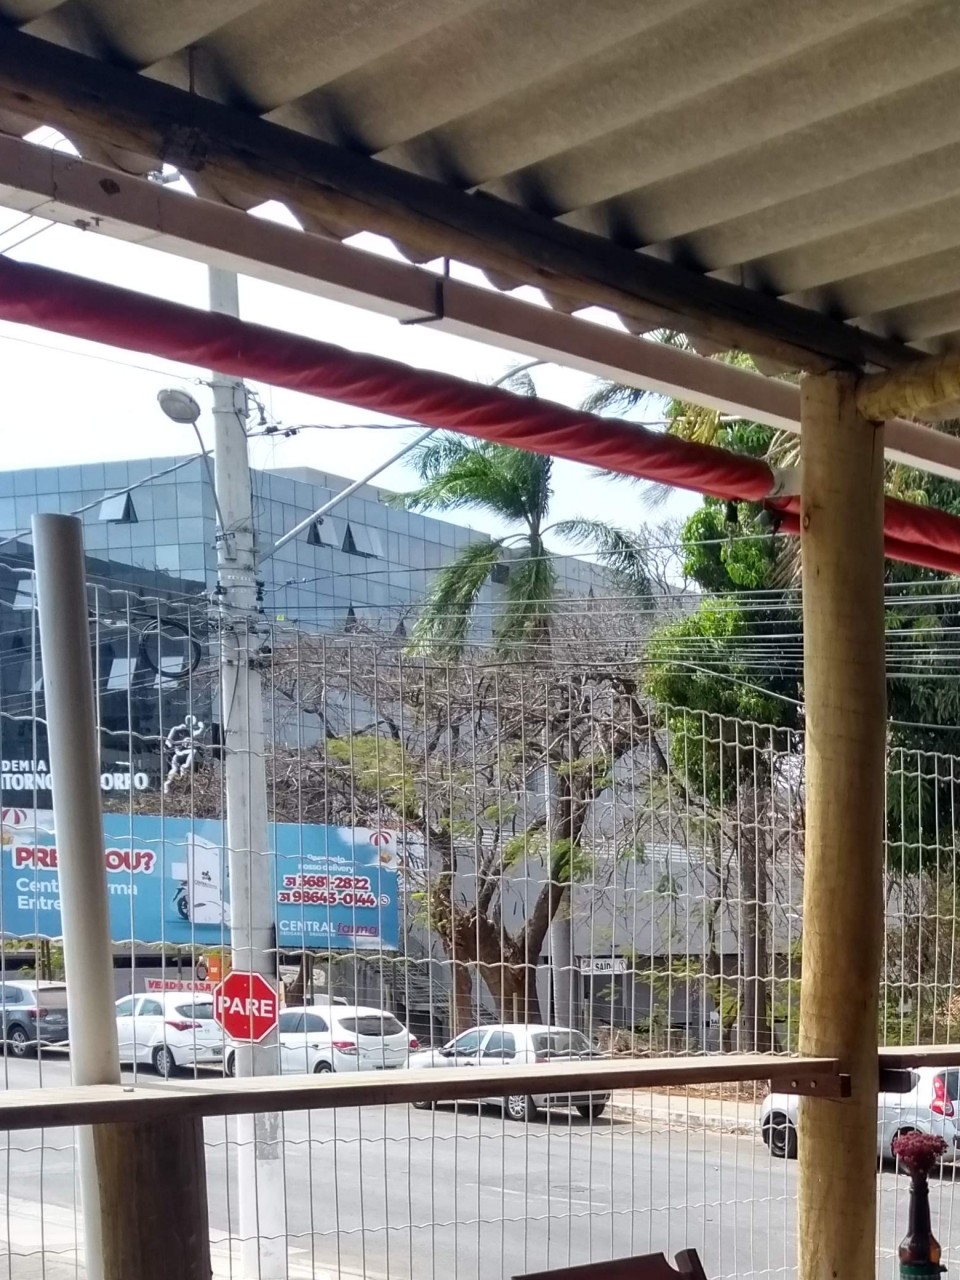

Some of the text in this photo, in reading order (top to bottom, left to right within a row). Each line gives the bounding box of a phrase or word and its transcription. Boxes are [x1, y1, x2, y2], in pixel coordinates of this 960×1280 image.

[101, 773, 148, 790] ORPO
[16, 878, 58, 892] Cent
[280, 920, 336, 932] CENTRAL
[218, 996, 273, 1018] PARE
